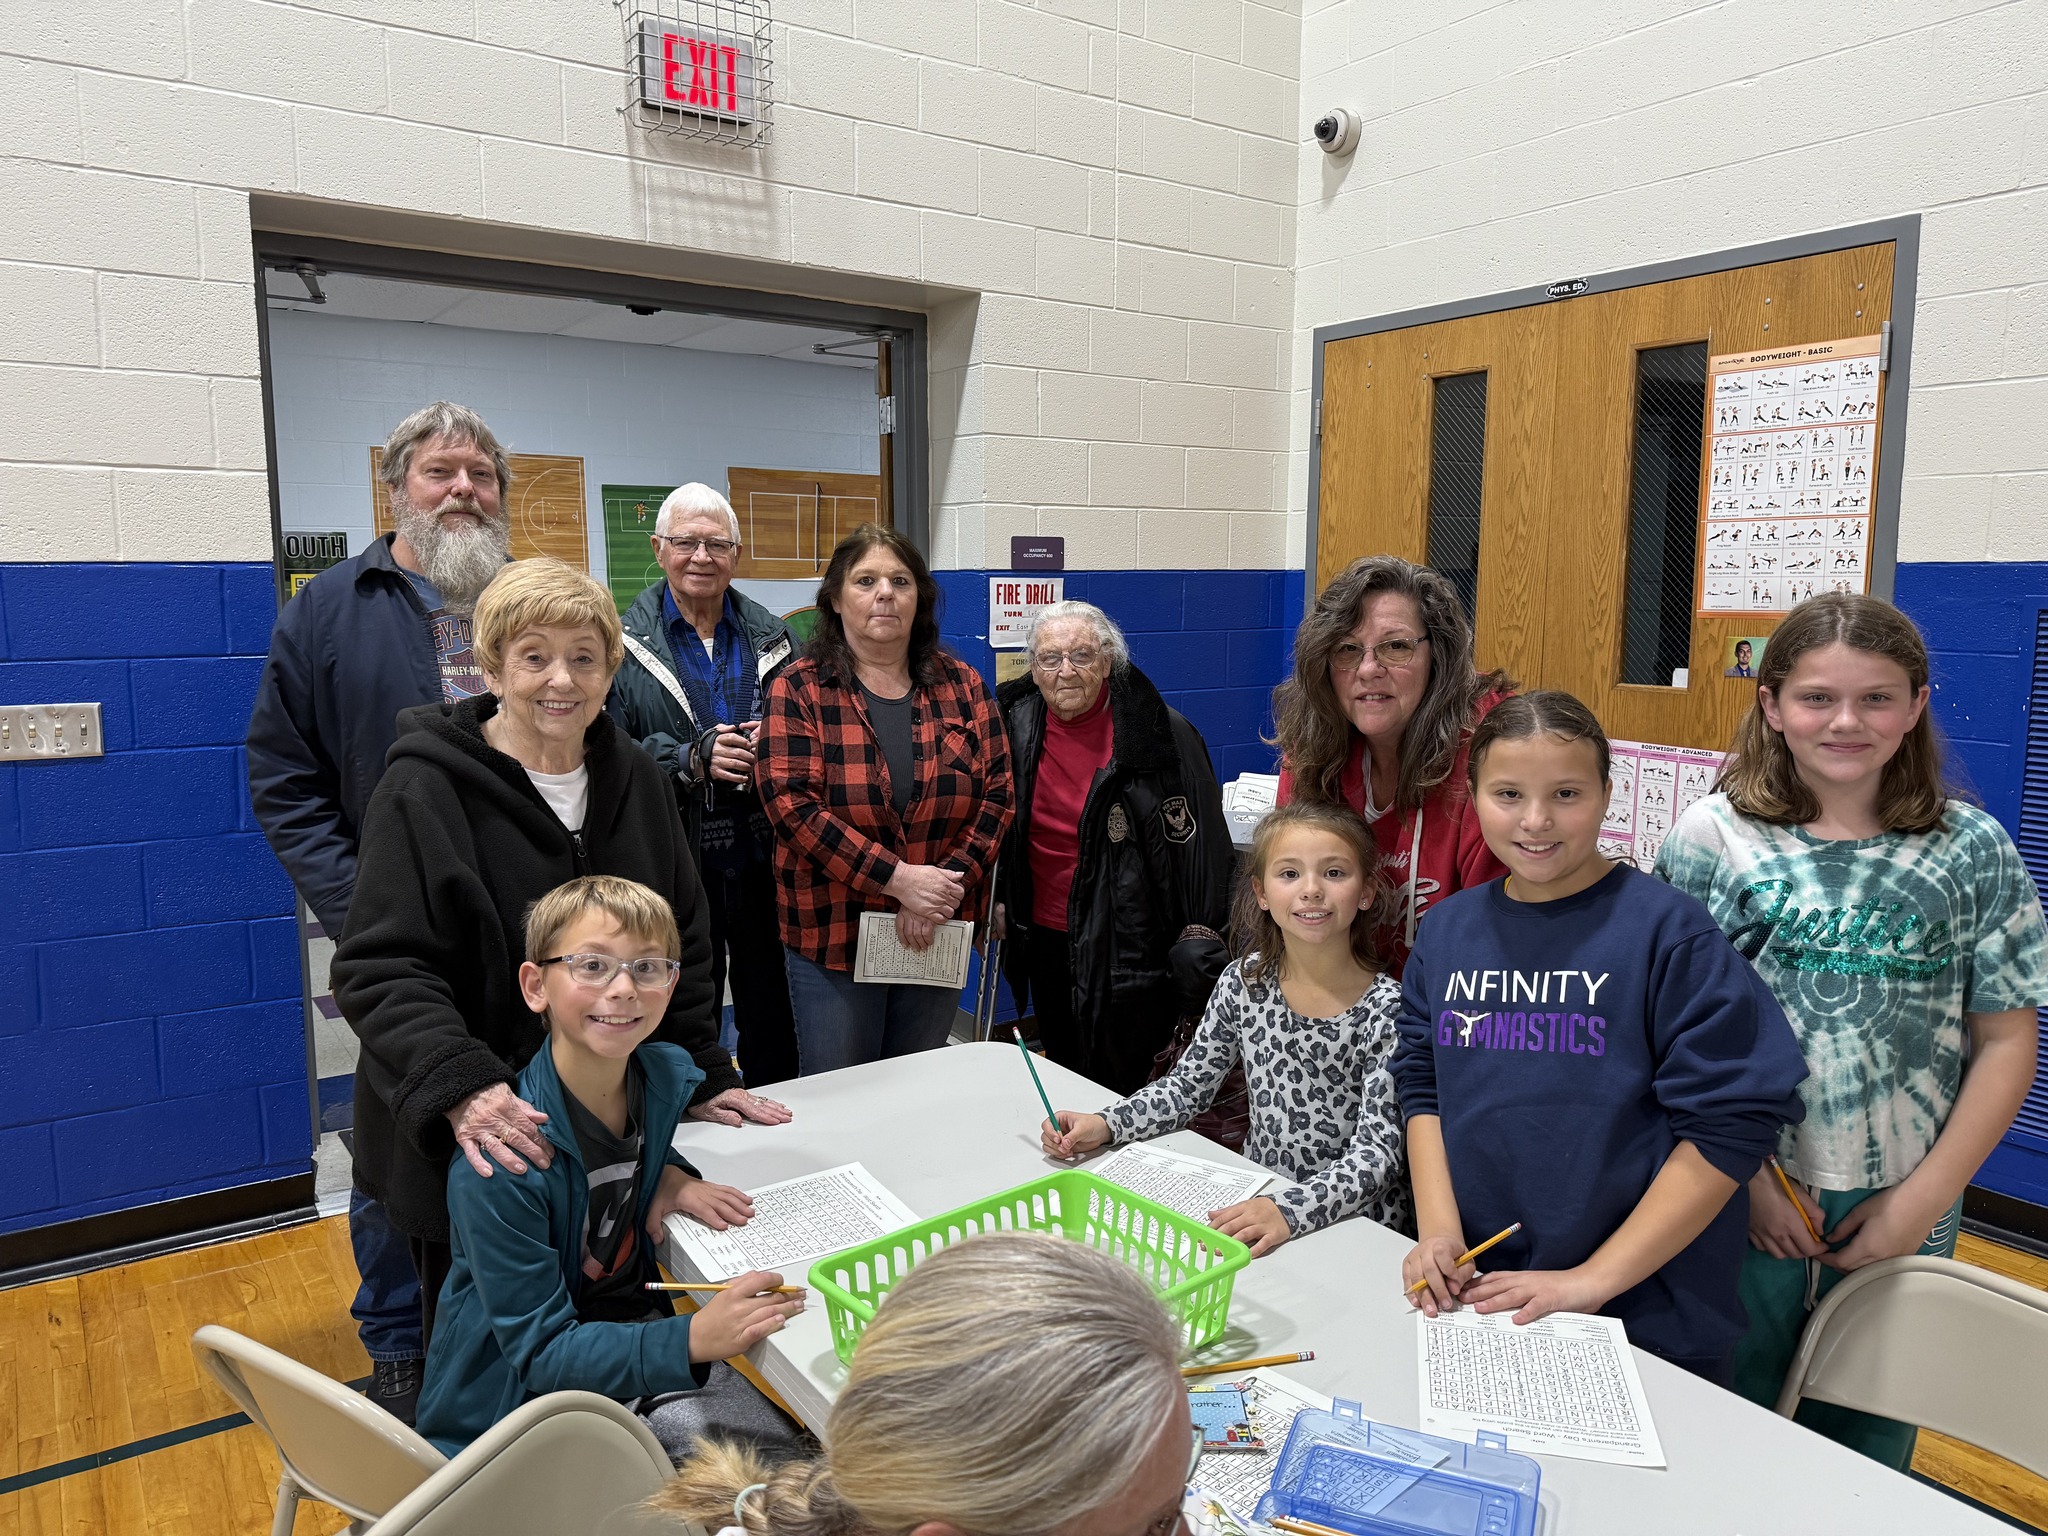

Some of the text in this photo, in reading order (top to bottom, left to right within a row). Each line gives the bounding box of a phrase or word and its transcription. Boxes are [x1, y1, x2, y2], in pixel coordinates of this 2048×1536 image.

[663, 33, 741, 112] EXIT
[1550, 284, 1571, 295] PHYS.
[1750, 350, 1802, 362] BODYWEIGHT
[1808, 346, 1833, 356] BASIC
[282, 534, 346, 558] OUTH
[996, 584, 1056, 605] FIRE DRILL
[442, 666, 482, 676] HARLEY-DAV
[1641, 744, 1677, 753] BODYWEIGHT
[1682, 749, 1713, 757] ADVANCED
[1171, 826, 1191, 838] SECURITY
[1728, 879, 1957, 960] Justice
[1444, 970, 1610, 1006] INFINITY
[1437, 1009, 1607, 1057] GYMNASTICS
